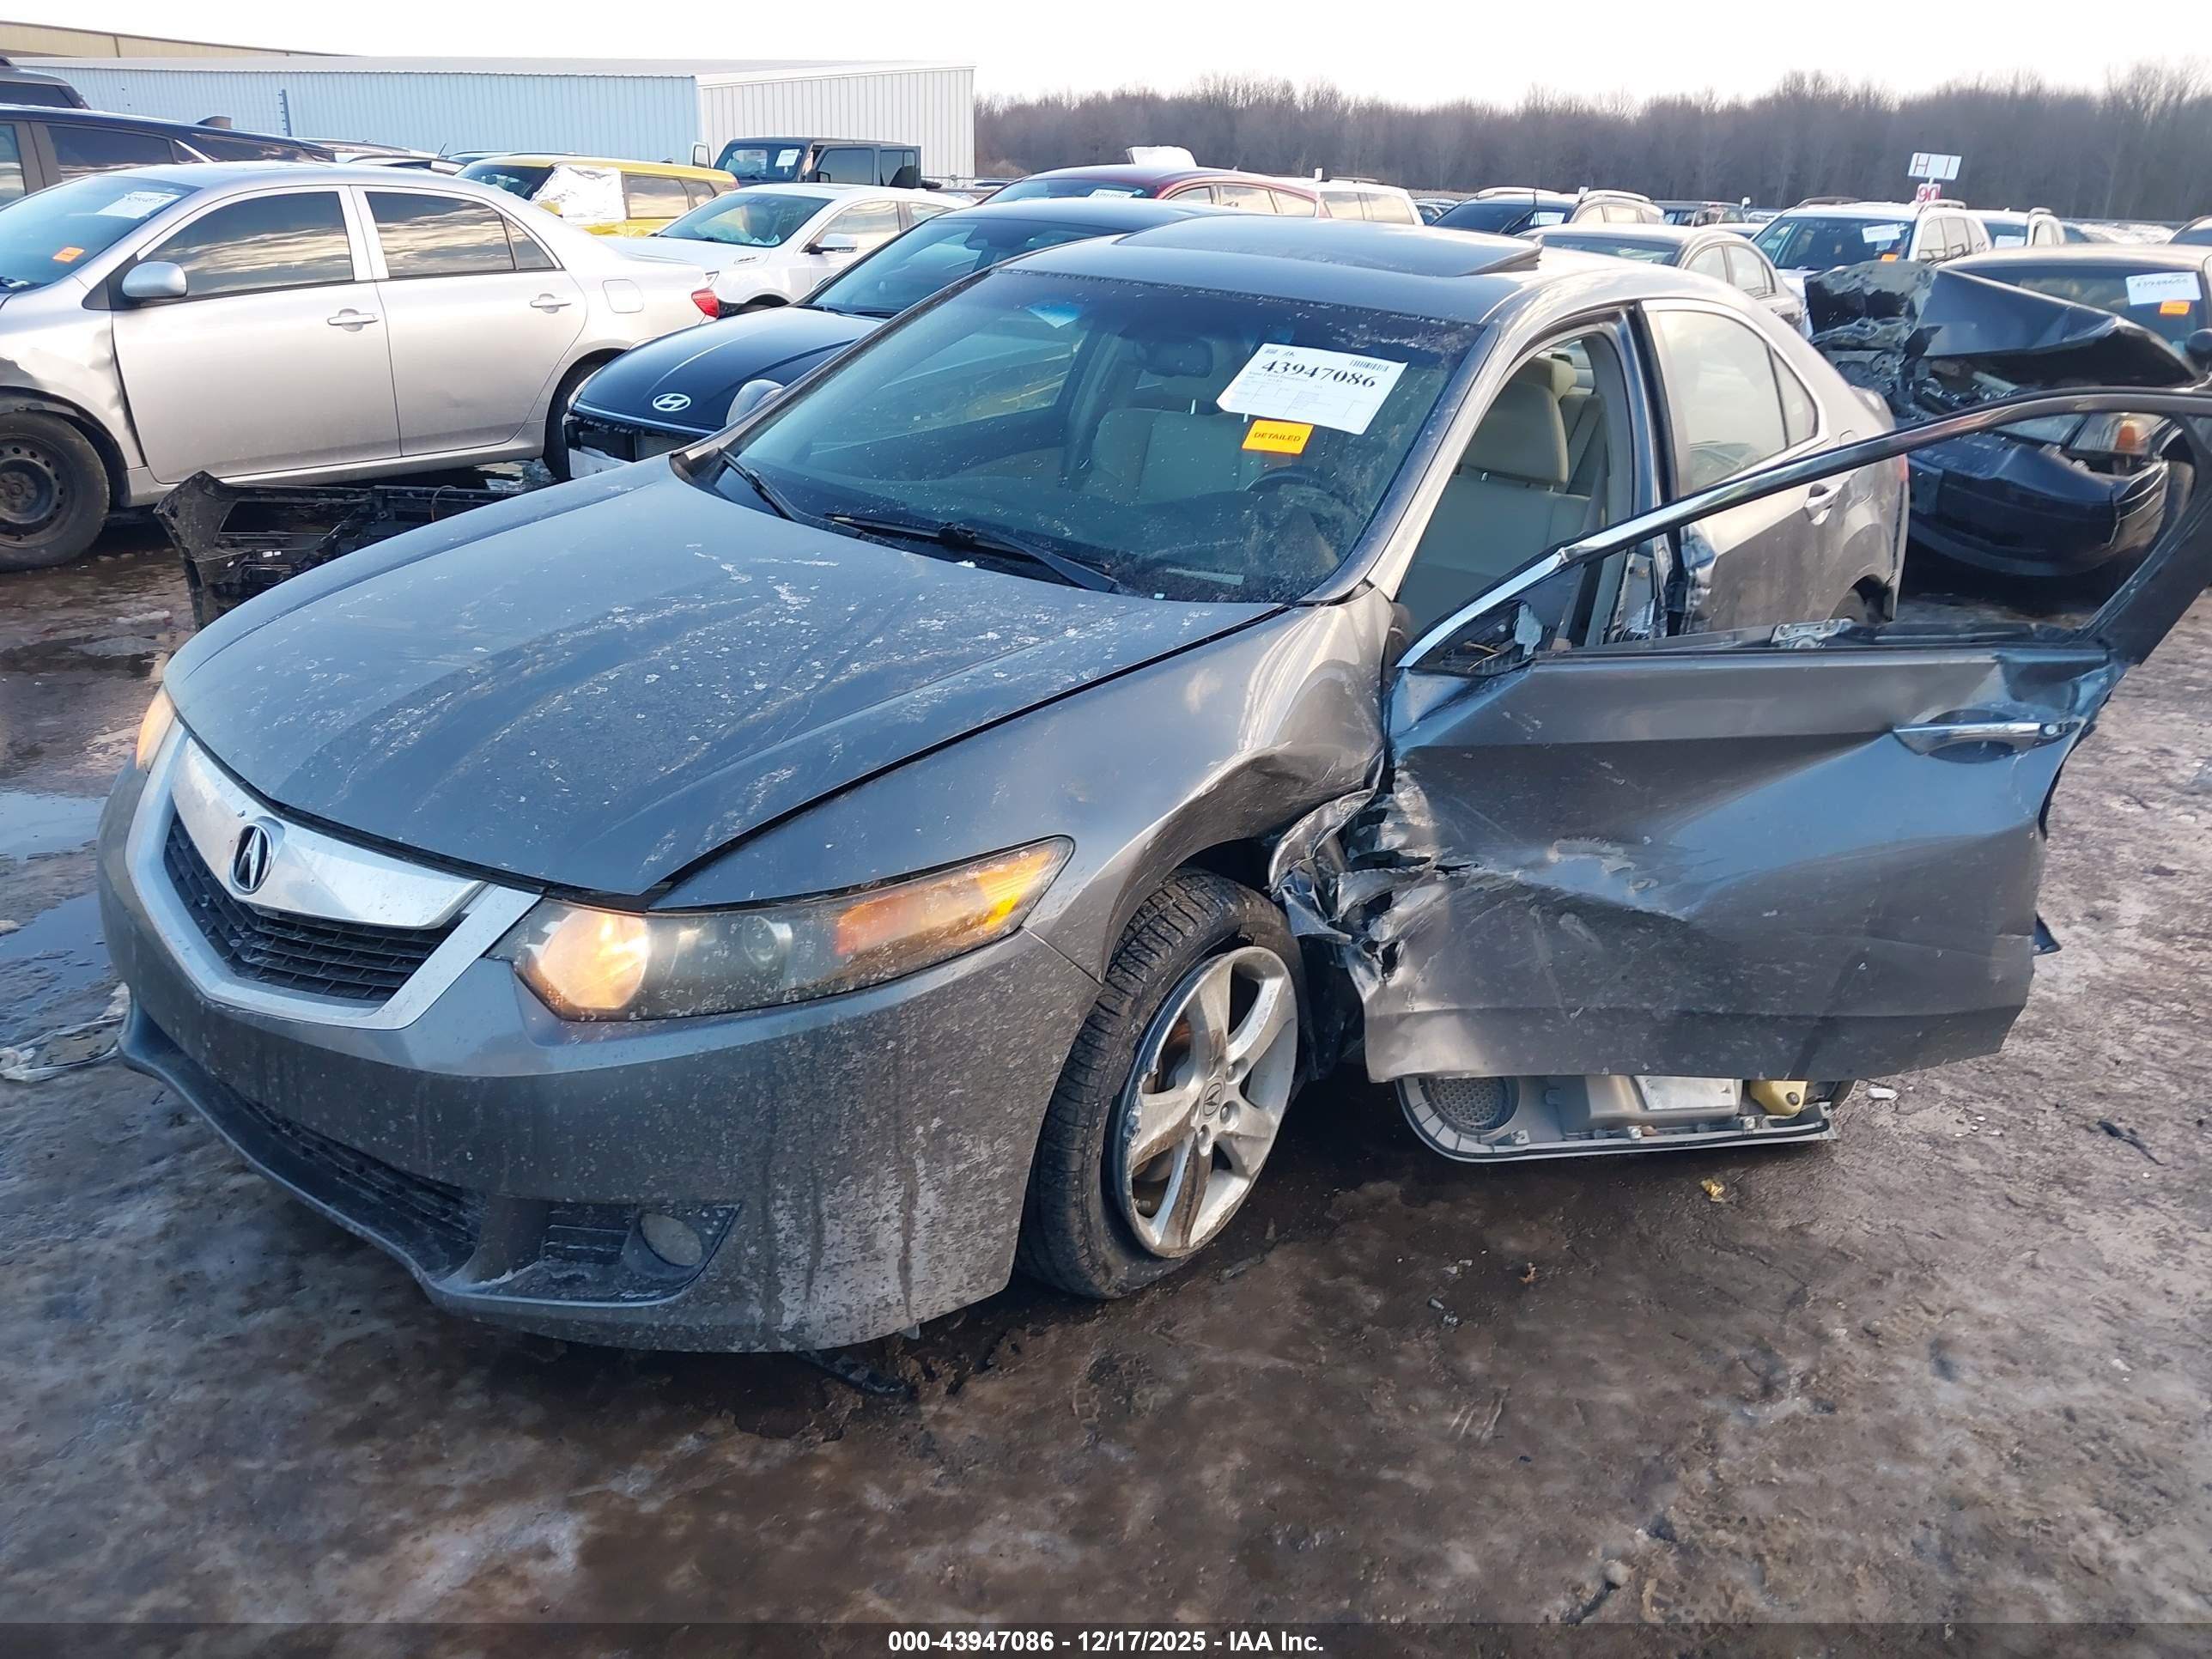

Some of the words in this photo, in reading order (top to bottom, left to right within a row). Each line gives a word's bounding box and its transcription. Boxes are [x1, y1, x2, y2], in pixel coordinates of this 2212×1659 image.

[1913, 155, 1930, 175] H
[1261, 360, 1377, 388] 43947086
[1254, 432, 1301, 442] DETAILED
